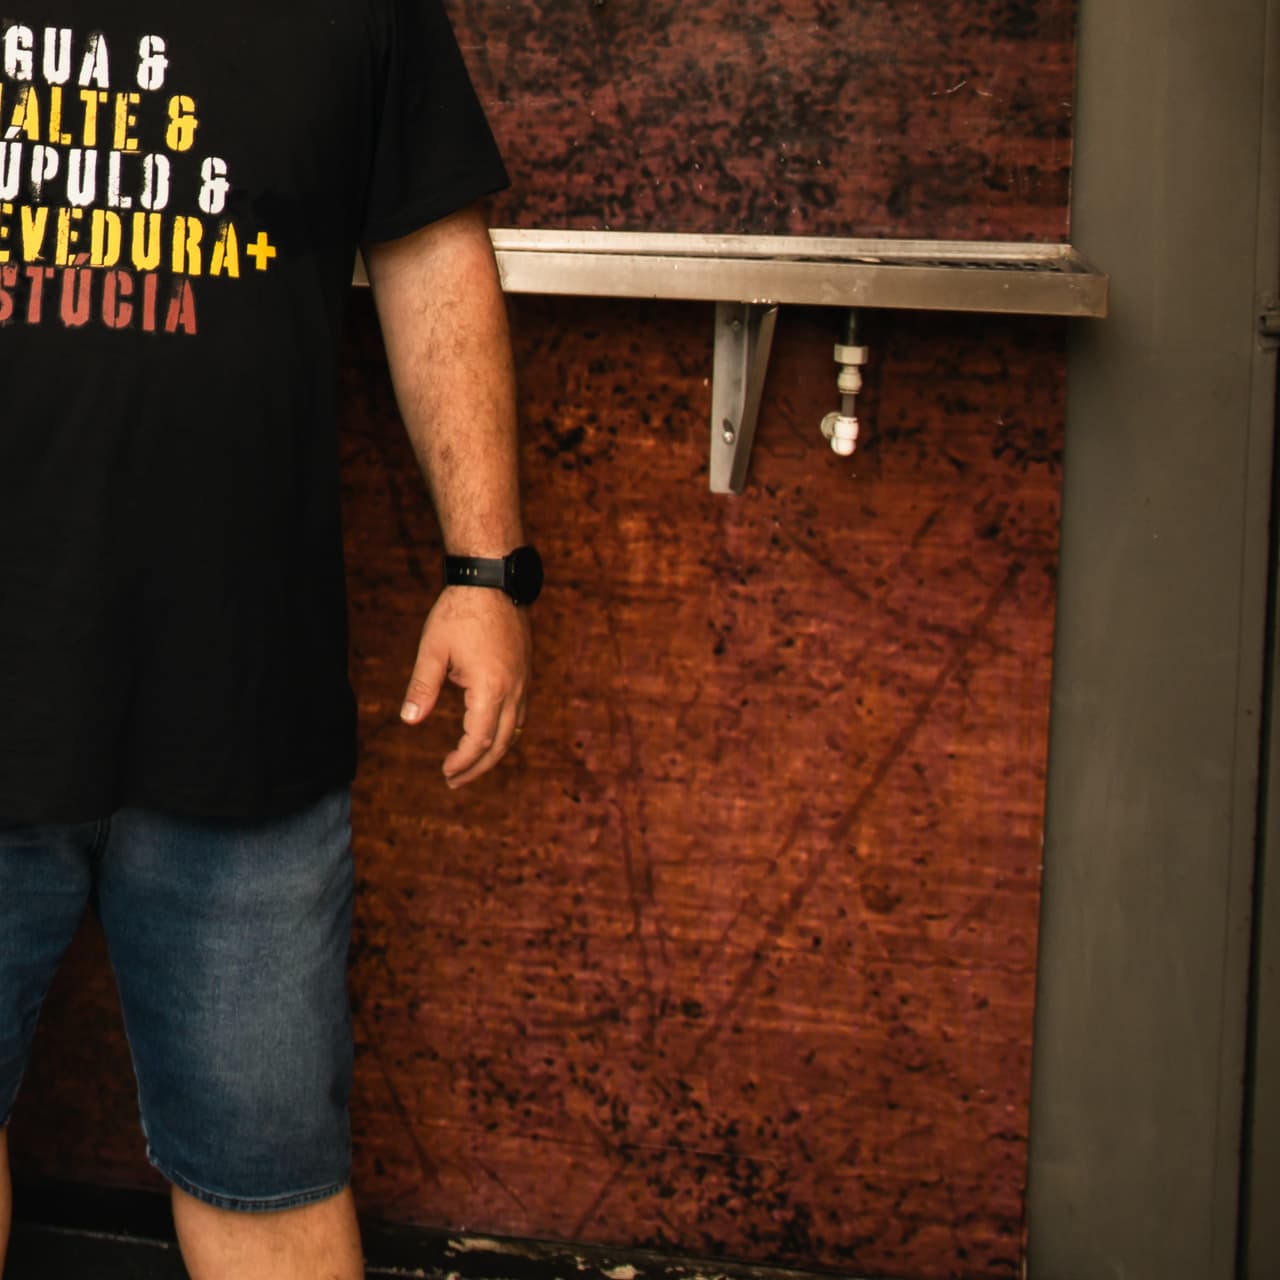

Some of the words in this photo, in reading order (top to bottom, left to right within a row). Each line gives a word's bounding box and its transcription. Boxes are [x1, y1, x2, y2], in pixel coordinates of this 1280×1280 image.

[136, 34, 168, 91] &
[165, 94, 198, 152] &
[198, 156, 230, 215] &
